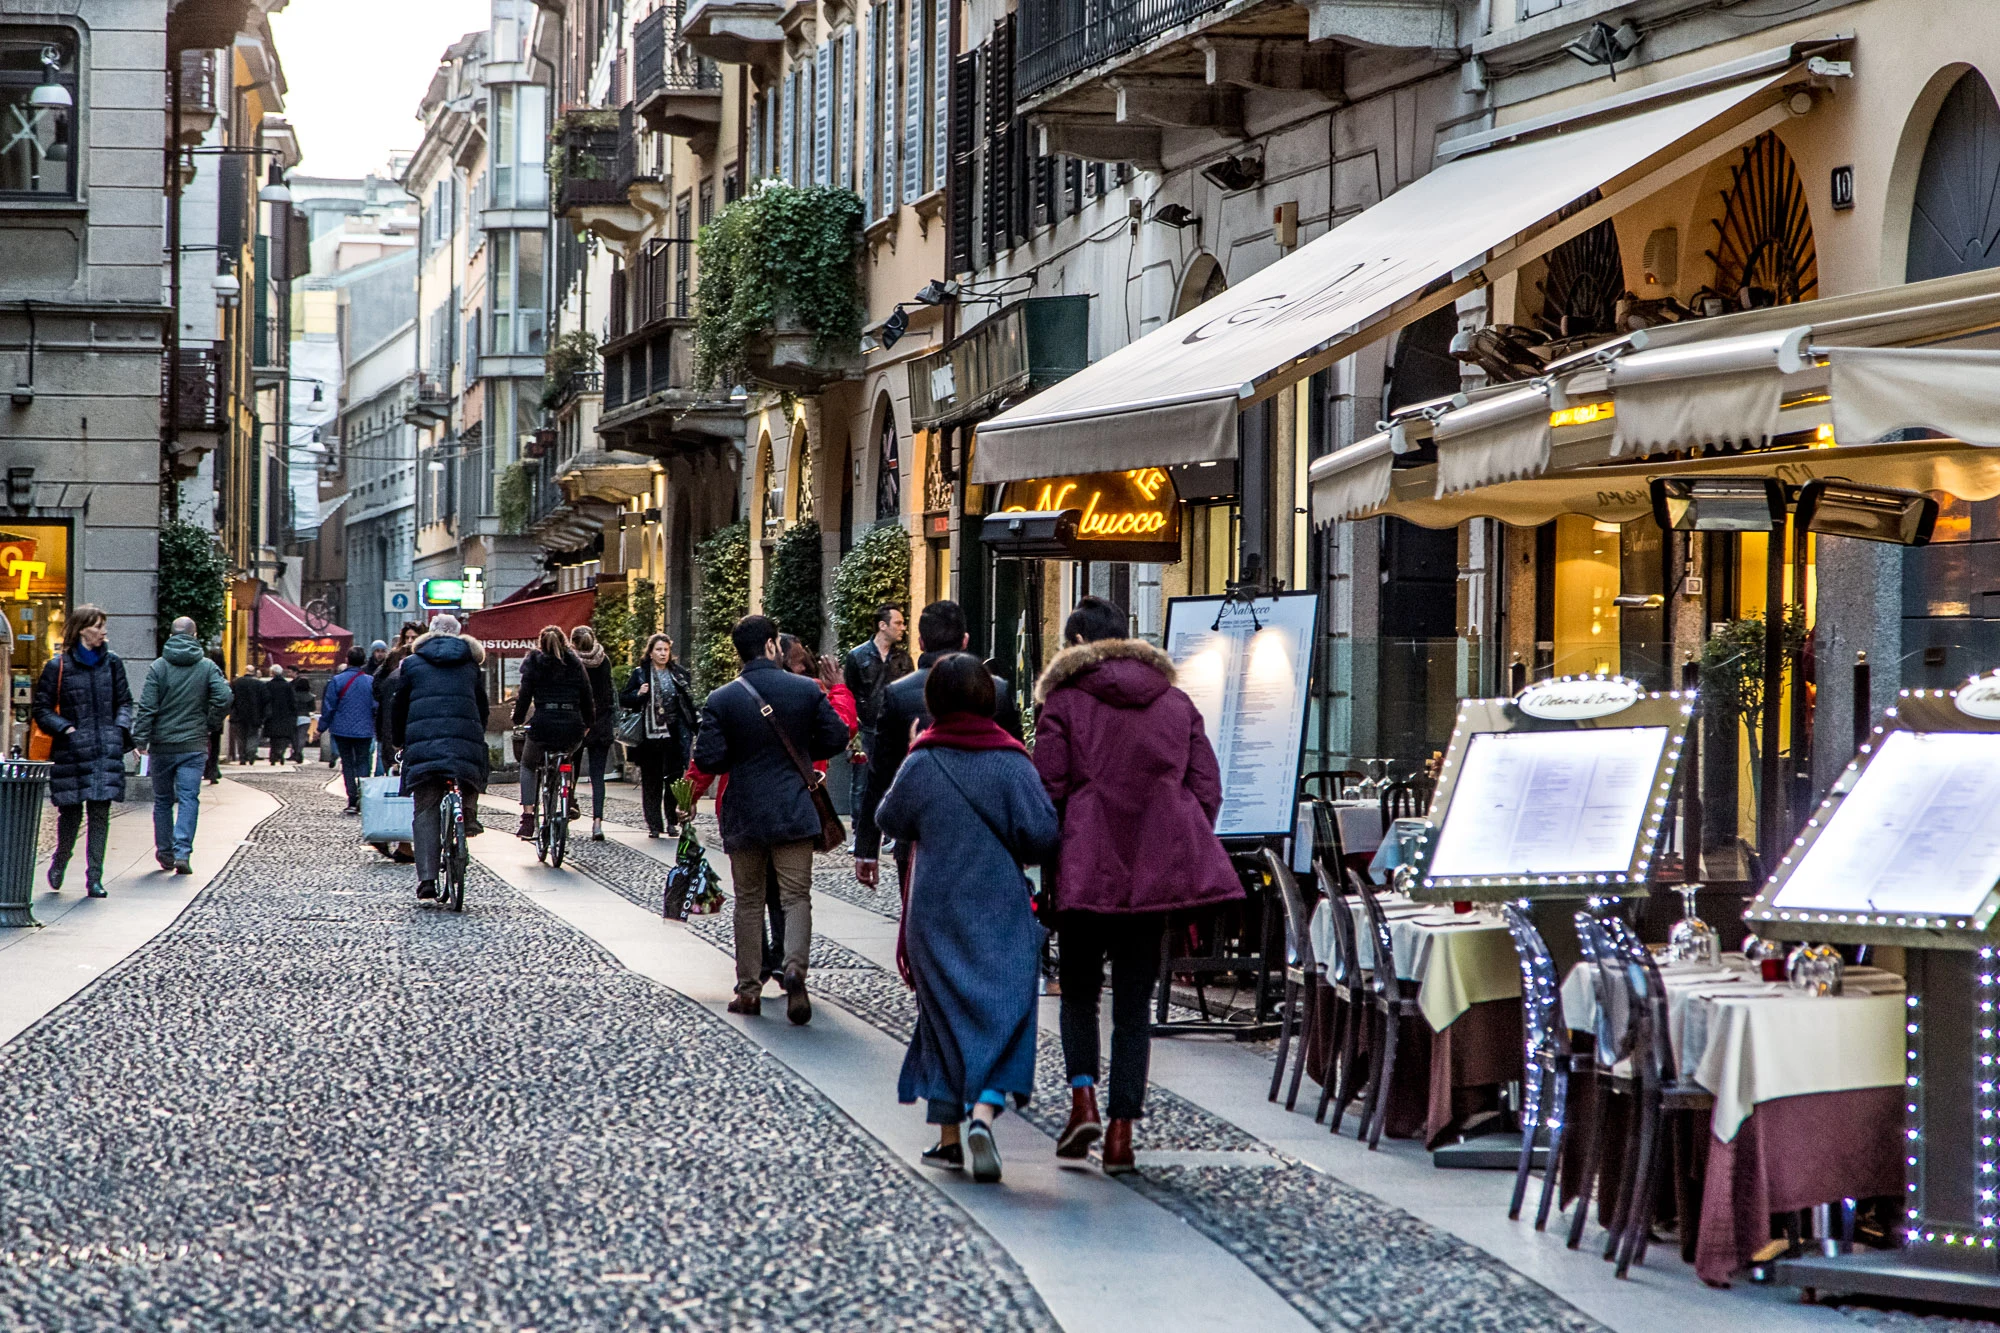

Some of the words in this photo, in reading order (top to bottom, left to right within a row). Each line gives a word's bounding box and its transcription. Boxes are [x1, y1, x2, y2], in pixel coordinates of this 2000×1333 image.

[1836, 171, 1851, 202] 10
[1005, 483, 1167, 535] Nbucco
[681, 878, 699, 918] ROSES
